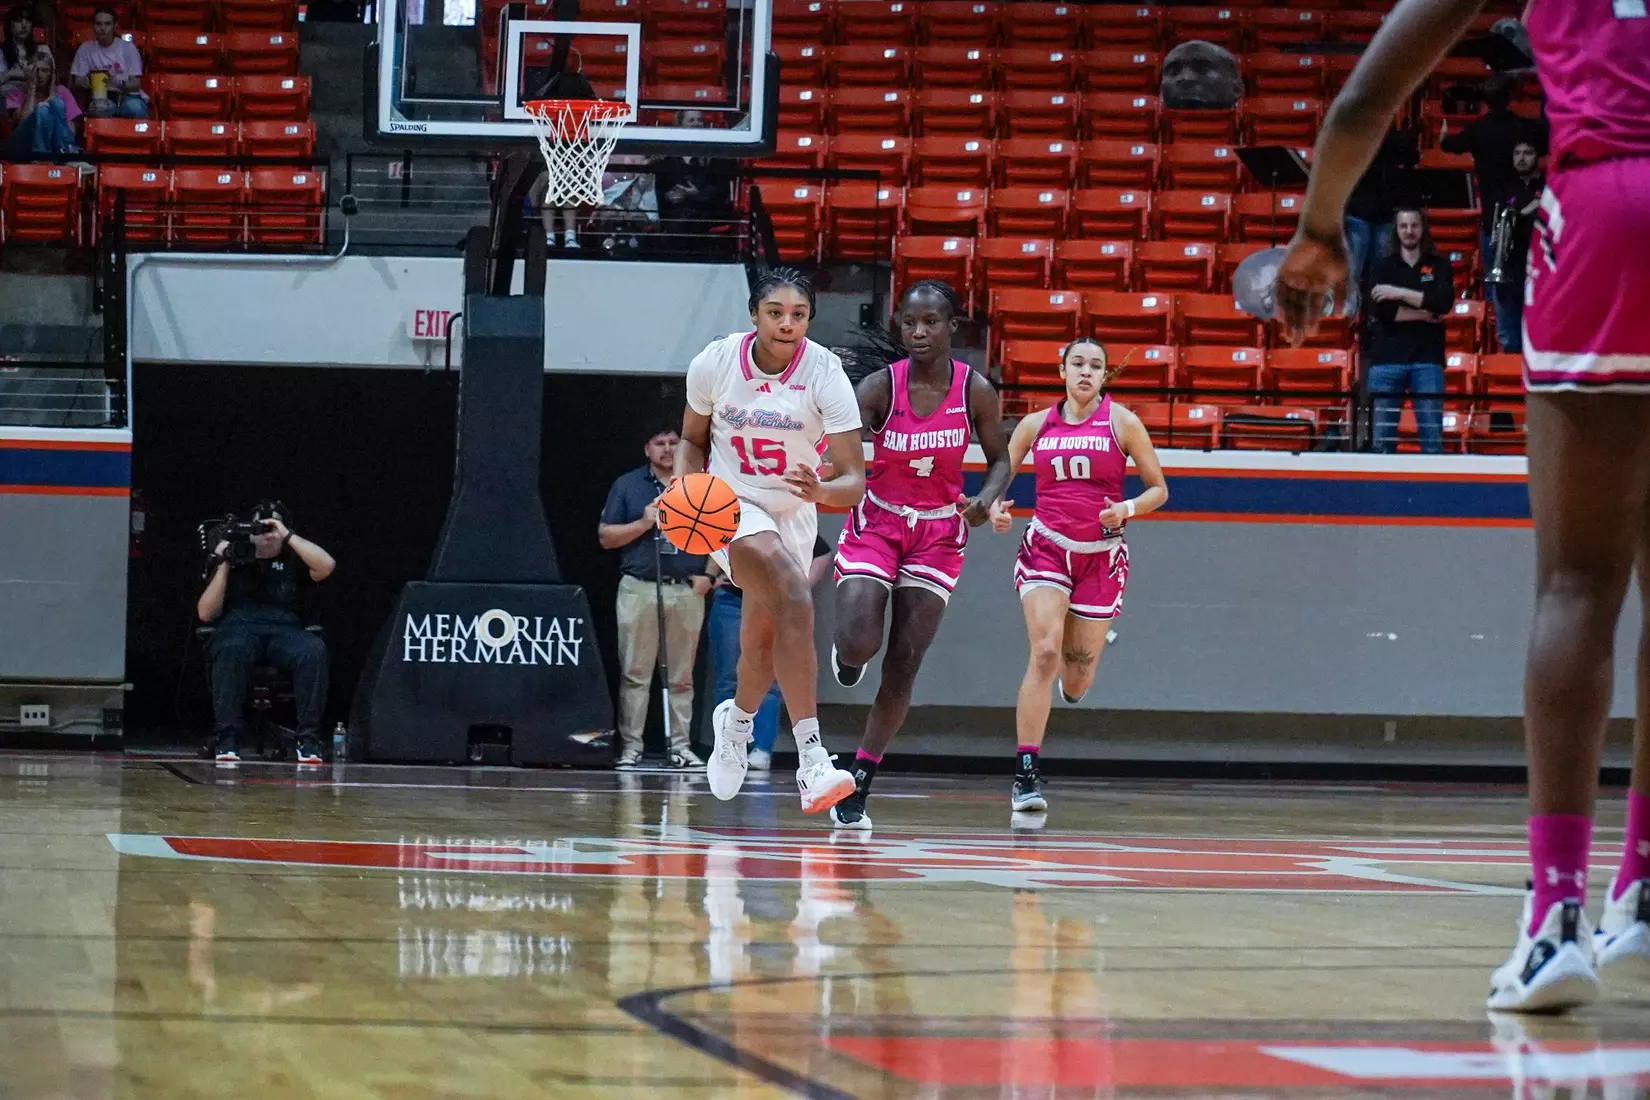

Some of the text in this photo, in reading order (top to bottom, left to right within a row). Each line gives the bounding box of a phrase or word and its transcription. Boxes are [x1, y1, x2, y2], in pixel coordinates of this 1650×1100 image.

[389, 123, 427, 132] SPALDING
[415, 310, 450, 337] EXIT
[719, 404, 805, 431] Lady Techsters
[883, 428, 966, 452] SAM HOUSTON
[1036, 436, 1110, 452] SAM HOUSTON
[730, 436, 787, 476] 15
[908, 456, 935, 478] 4
[1050, 455, 1092, 481] 10
[403, 609, 584, 648] MEMORIAL
[402, 636, 581, 666] HERMANN
